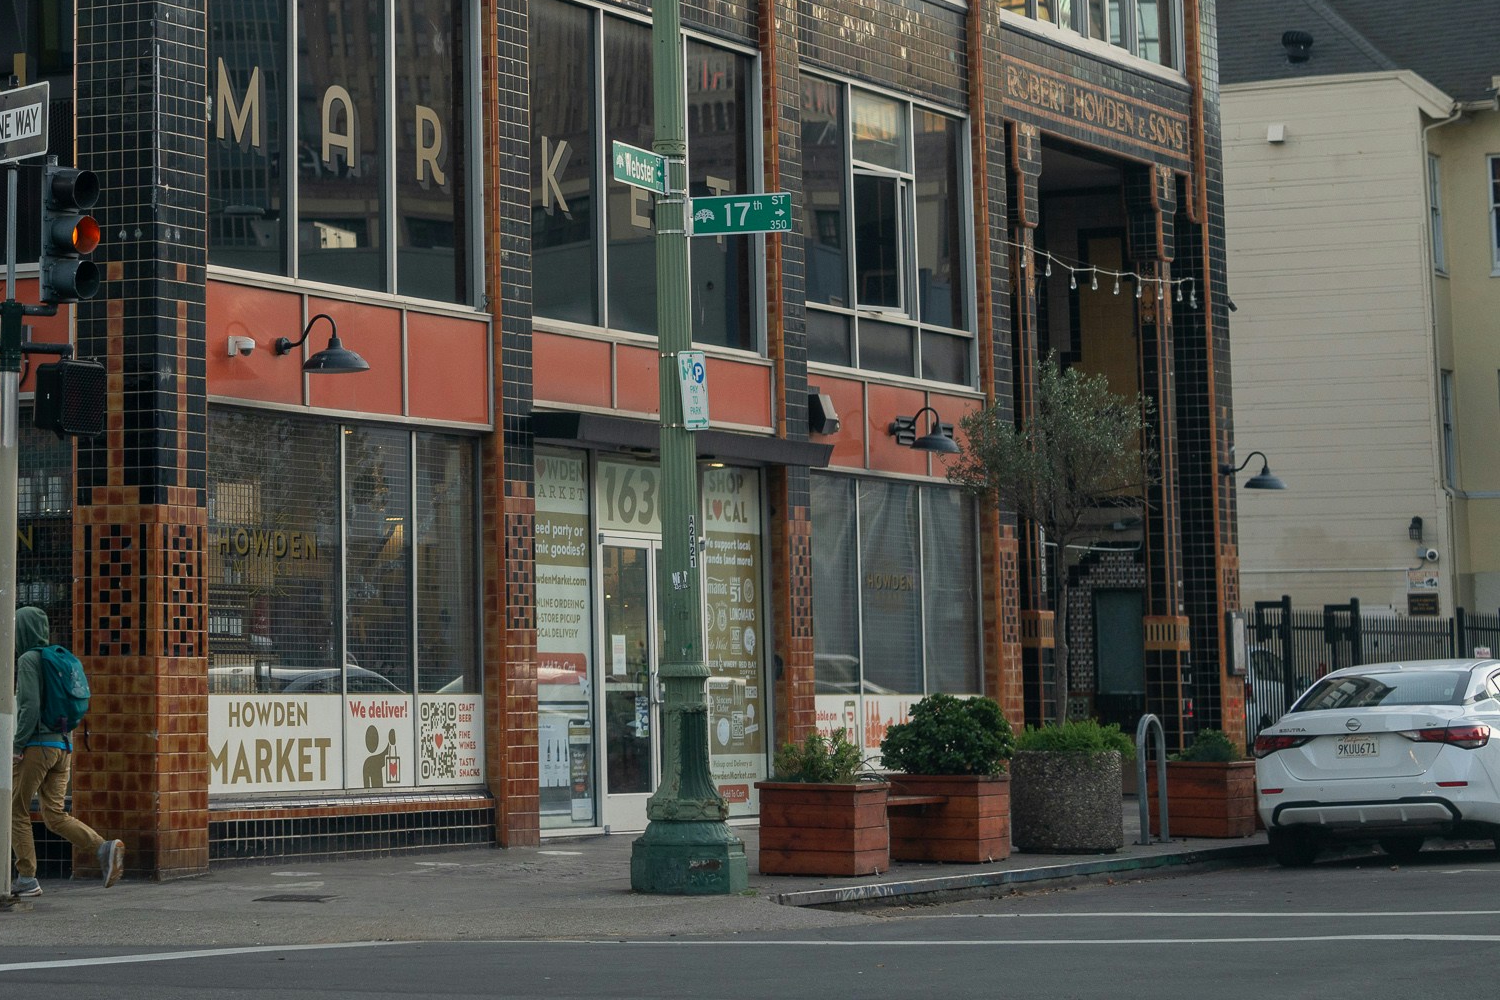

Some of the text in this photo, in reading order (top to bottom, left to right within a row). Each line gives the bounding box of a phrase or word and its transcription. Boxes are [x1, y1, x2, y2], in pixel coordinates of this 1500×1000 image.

[1007, 65, 1183, 150] ROBERT HOWDEN & SONS
[15, 106, 39, 137] WAY
[625, 152, 654, 184] Webster
[724, 195, 785, 227] 17th ST
[770, 220, 787, 230] 350
[690, 385, 699, 394] PAY
[692, 396, 699, 405] TO
[690, 406, 702, 415] PARK
[709, 470, 744, 494] SHOP
[605, 466, 662, 525] 163
[552, 523, 573, 539] party
[574, 527, 584, 537] or
[217, 527, 318, 561] HOWDEN
[550, 541, 586, 558] goodies?
[714, 539, 737, 552] support
[737, 540, 751, 551] local
[723, 553, 736, 565] (and
[736, 554, 753, 567] more)
[866, 573, 914, 592] HOWDEN
[730, 586, 741, 603] 51
[554, 599, 585, 610] ORDERING
[537, 613, 581, 624] -STORE PICKUP
[729, 607, 755, 621] LONGMANS
[552, 628, 579, 639] DELIVERY
[228, 701, 308, 728] HOWDEN
[349, 700, 408, 719] We deliver!
[458, 703, 476, 712] CRAFT
[458, 713, 472, 723] BEER
[815, 711, 837, 721] able on
[458, 730, 471, 739] FINE
[458, 741, 477, 750] WINES
[1338, 742, 1377, 756] 9KUU671
[207, 738, 332, 785] MARKET
[459, 757, 476, 767] TASTY
[459, 768, 480, 777] SNACKS
[723, 789, 745, 798] Add To Cart
